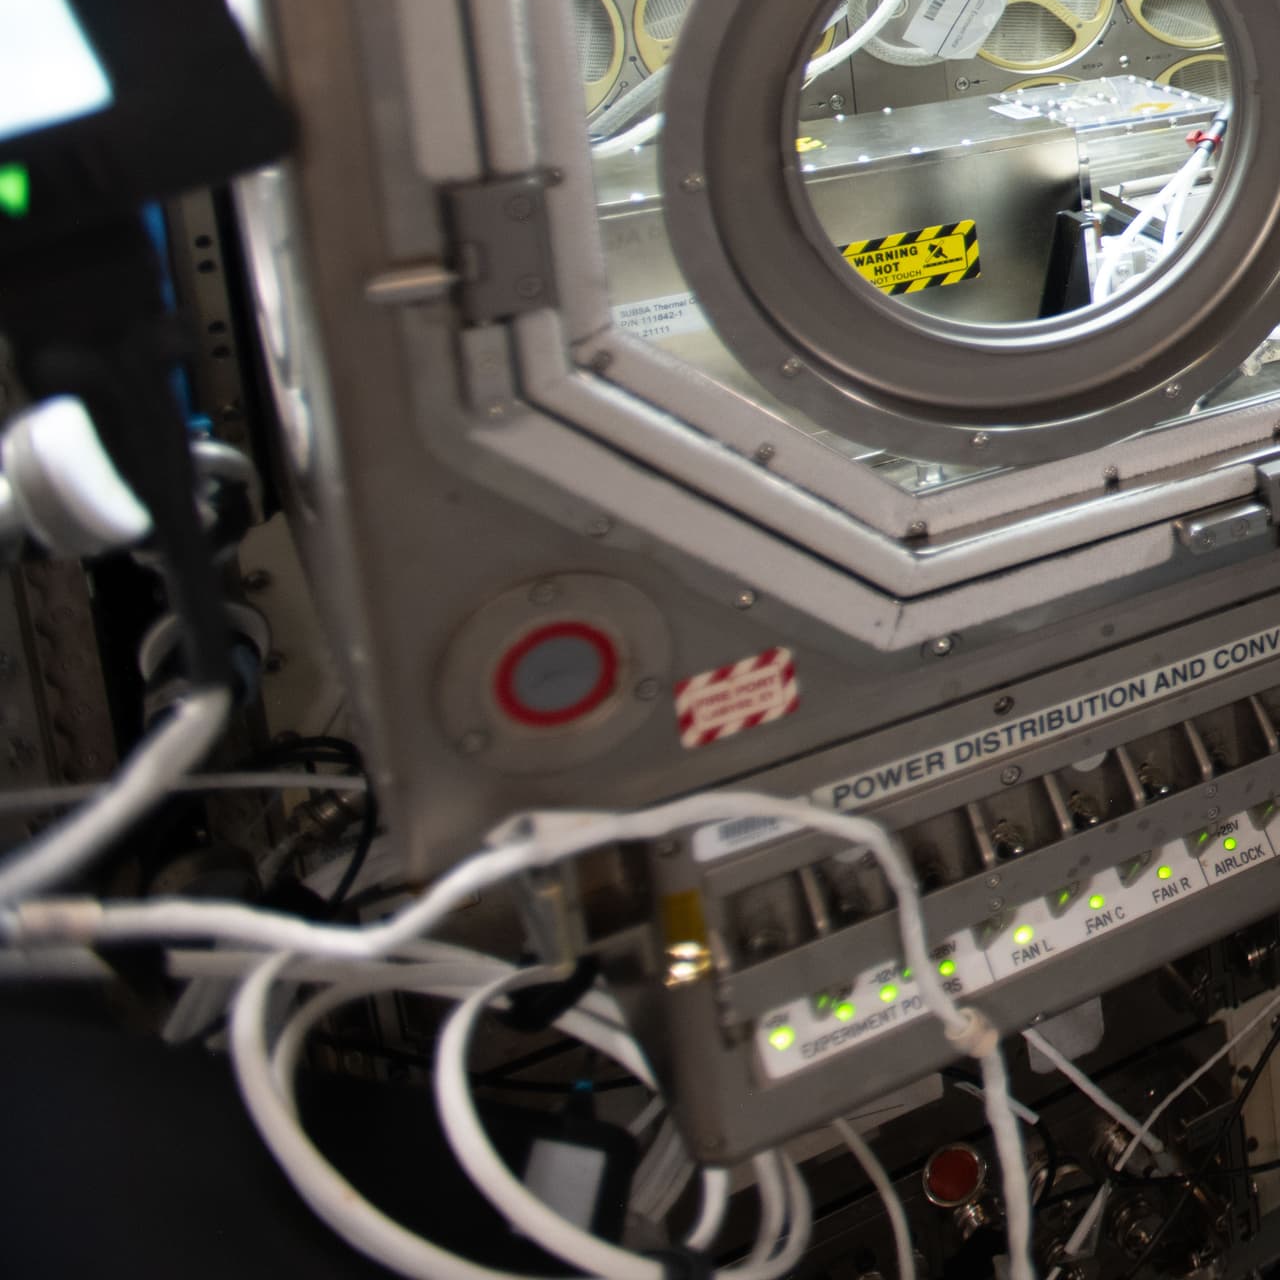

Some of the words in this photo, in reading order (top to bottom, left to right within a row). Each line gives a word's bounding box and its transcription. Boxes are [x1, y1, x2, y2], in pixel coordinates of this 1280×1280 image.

[854, 246, 918, 267] WARNING
[874, 262, 900, 276] HOT
[870, 275, 889, 286] NOT
[891, 269, 922, 281] TOUCH
[620, 306, 651, 319] SUBSA
[653, 299, 688, 311] Thermal
[620, 319, 639, 328] P/N
[832, 751, 945, 809] POWER
[953, 679, 1147, 765] DISTRIBUTION
[1153, 657, 1207, 693] AND
[1213, 844, 1265, 877] AIRLOCK
[1152, 885, 1178, 904] FAN
[1180, 876, 1192, 891] R
[1085, 915, 1113, 935] FAN
[1114, 905, 1126, 922] C
[1011, 944, 1042, 966] FAN
[1043, 938, 1055, 953] L
[801, 1004, 897, 1059] EXPERIMENT
